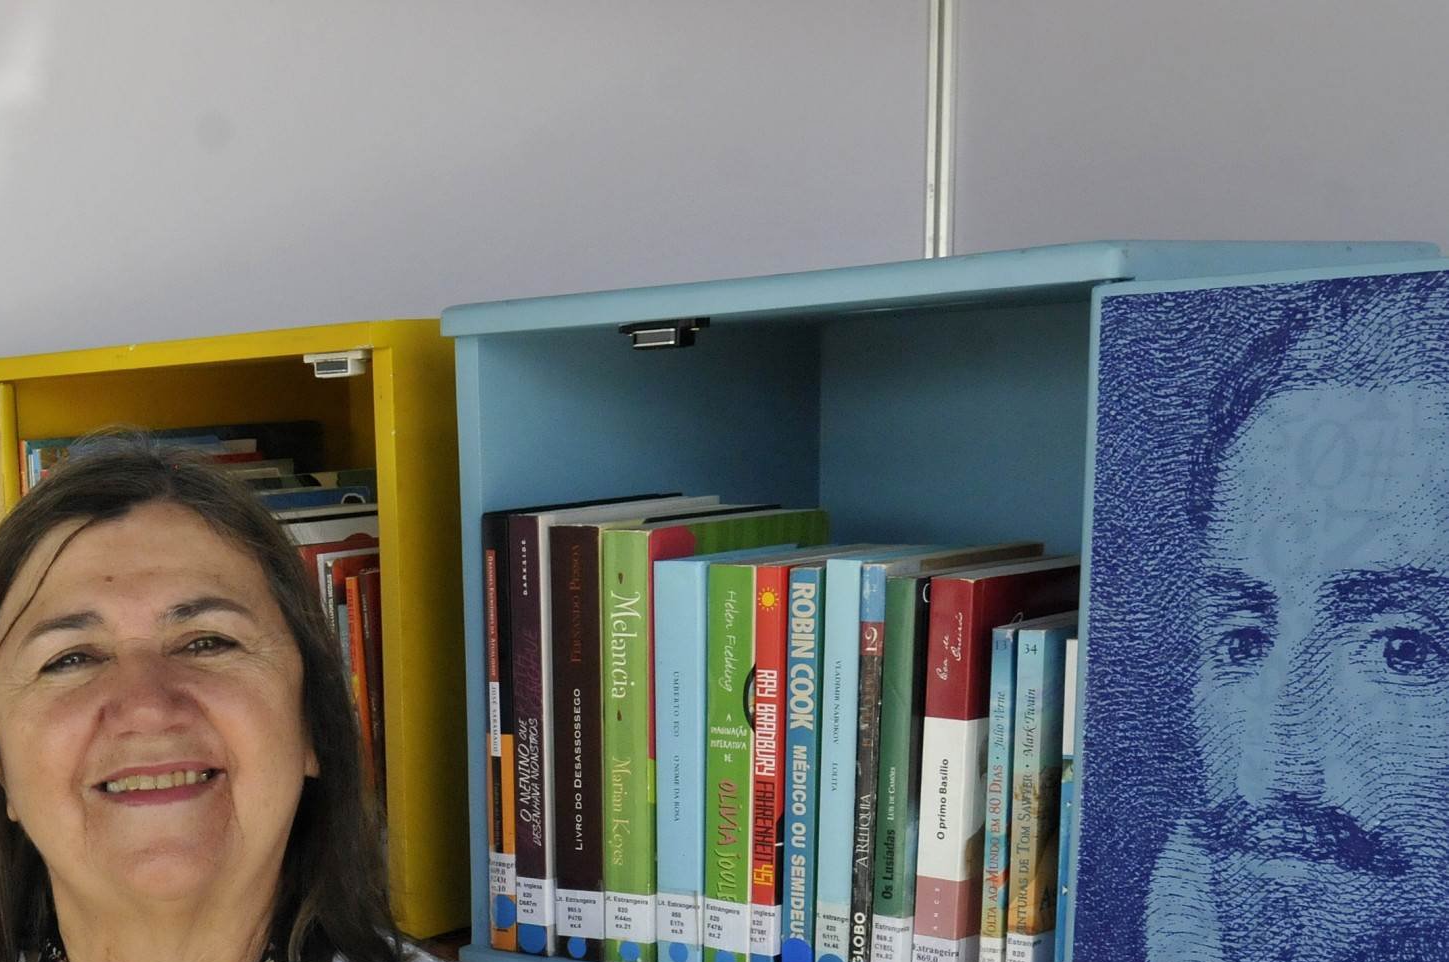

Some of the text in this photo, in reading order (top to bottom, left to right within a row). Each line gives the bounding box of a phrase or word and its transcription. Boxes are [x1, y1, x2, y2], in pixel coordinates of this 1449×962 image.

[610, 590, 641, 699] Melancia
[718, 590, 738, 693] Helen Fielding
[789, 582, 816, 731] ROBIN COOK
[1024, 643, 1038, 655] 34
[1023, 688, 1037, 722] Twain
[518, 719, 532, 822] O MENINO QUE
[573, 688, 583, 851] LIVRO DO DESASSOSSEGO
[753, 669, 778, 886] RAY BRADBURY FAHRENHEIT 451
[1023, 726, 1036, 757] Mark
[528, 717, 543, 847] DESENHAVA MONSTROS
[608, 757, 632, 866] Marian Keyes
[791, 744, 810, 816] MÉDICO
[936, 758, 949, 840] O primo Basílio
[989, 798, 1002, 814] 80
[790, 822, 807, 849] OU
[855, 856, 870, 870] A
[881, 828, 896, 900] Os Lusíadas
[1015, 826, 1031, 855] TOM
[1015, 877, 1030, 934] ENTURAS
